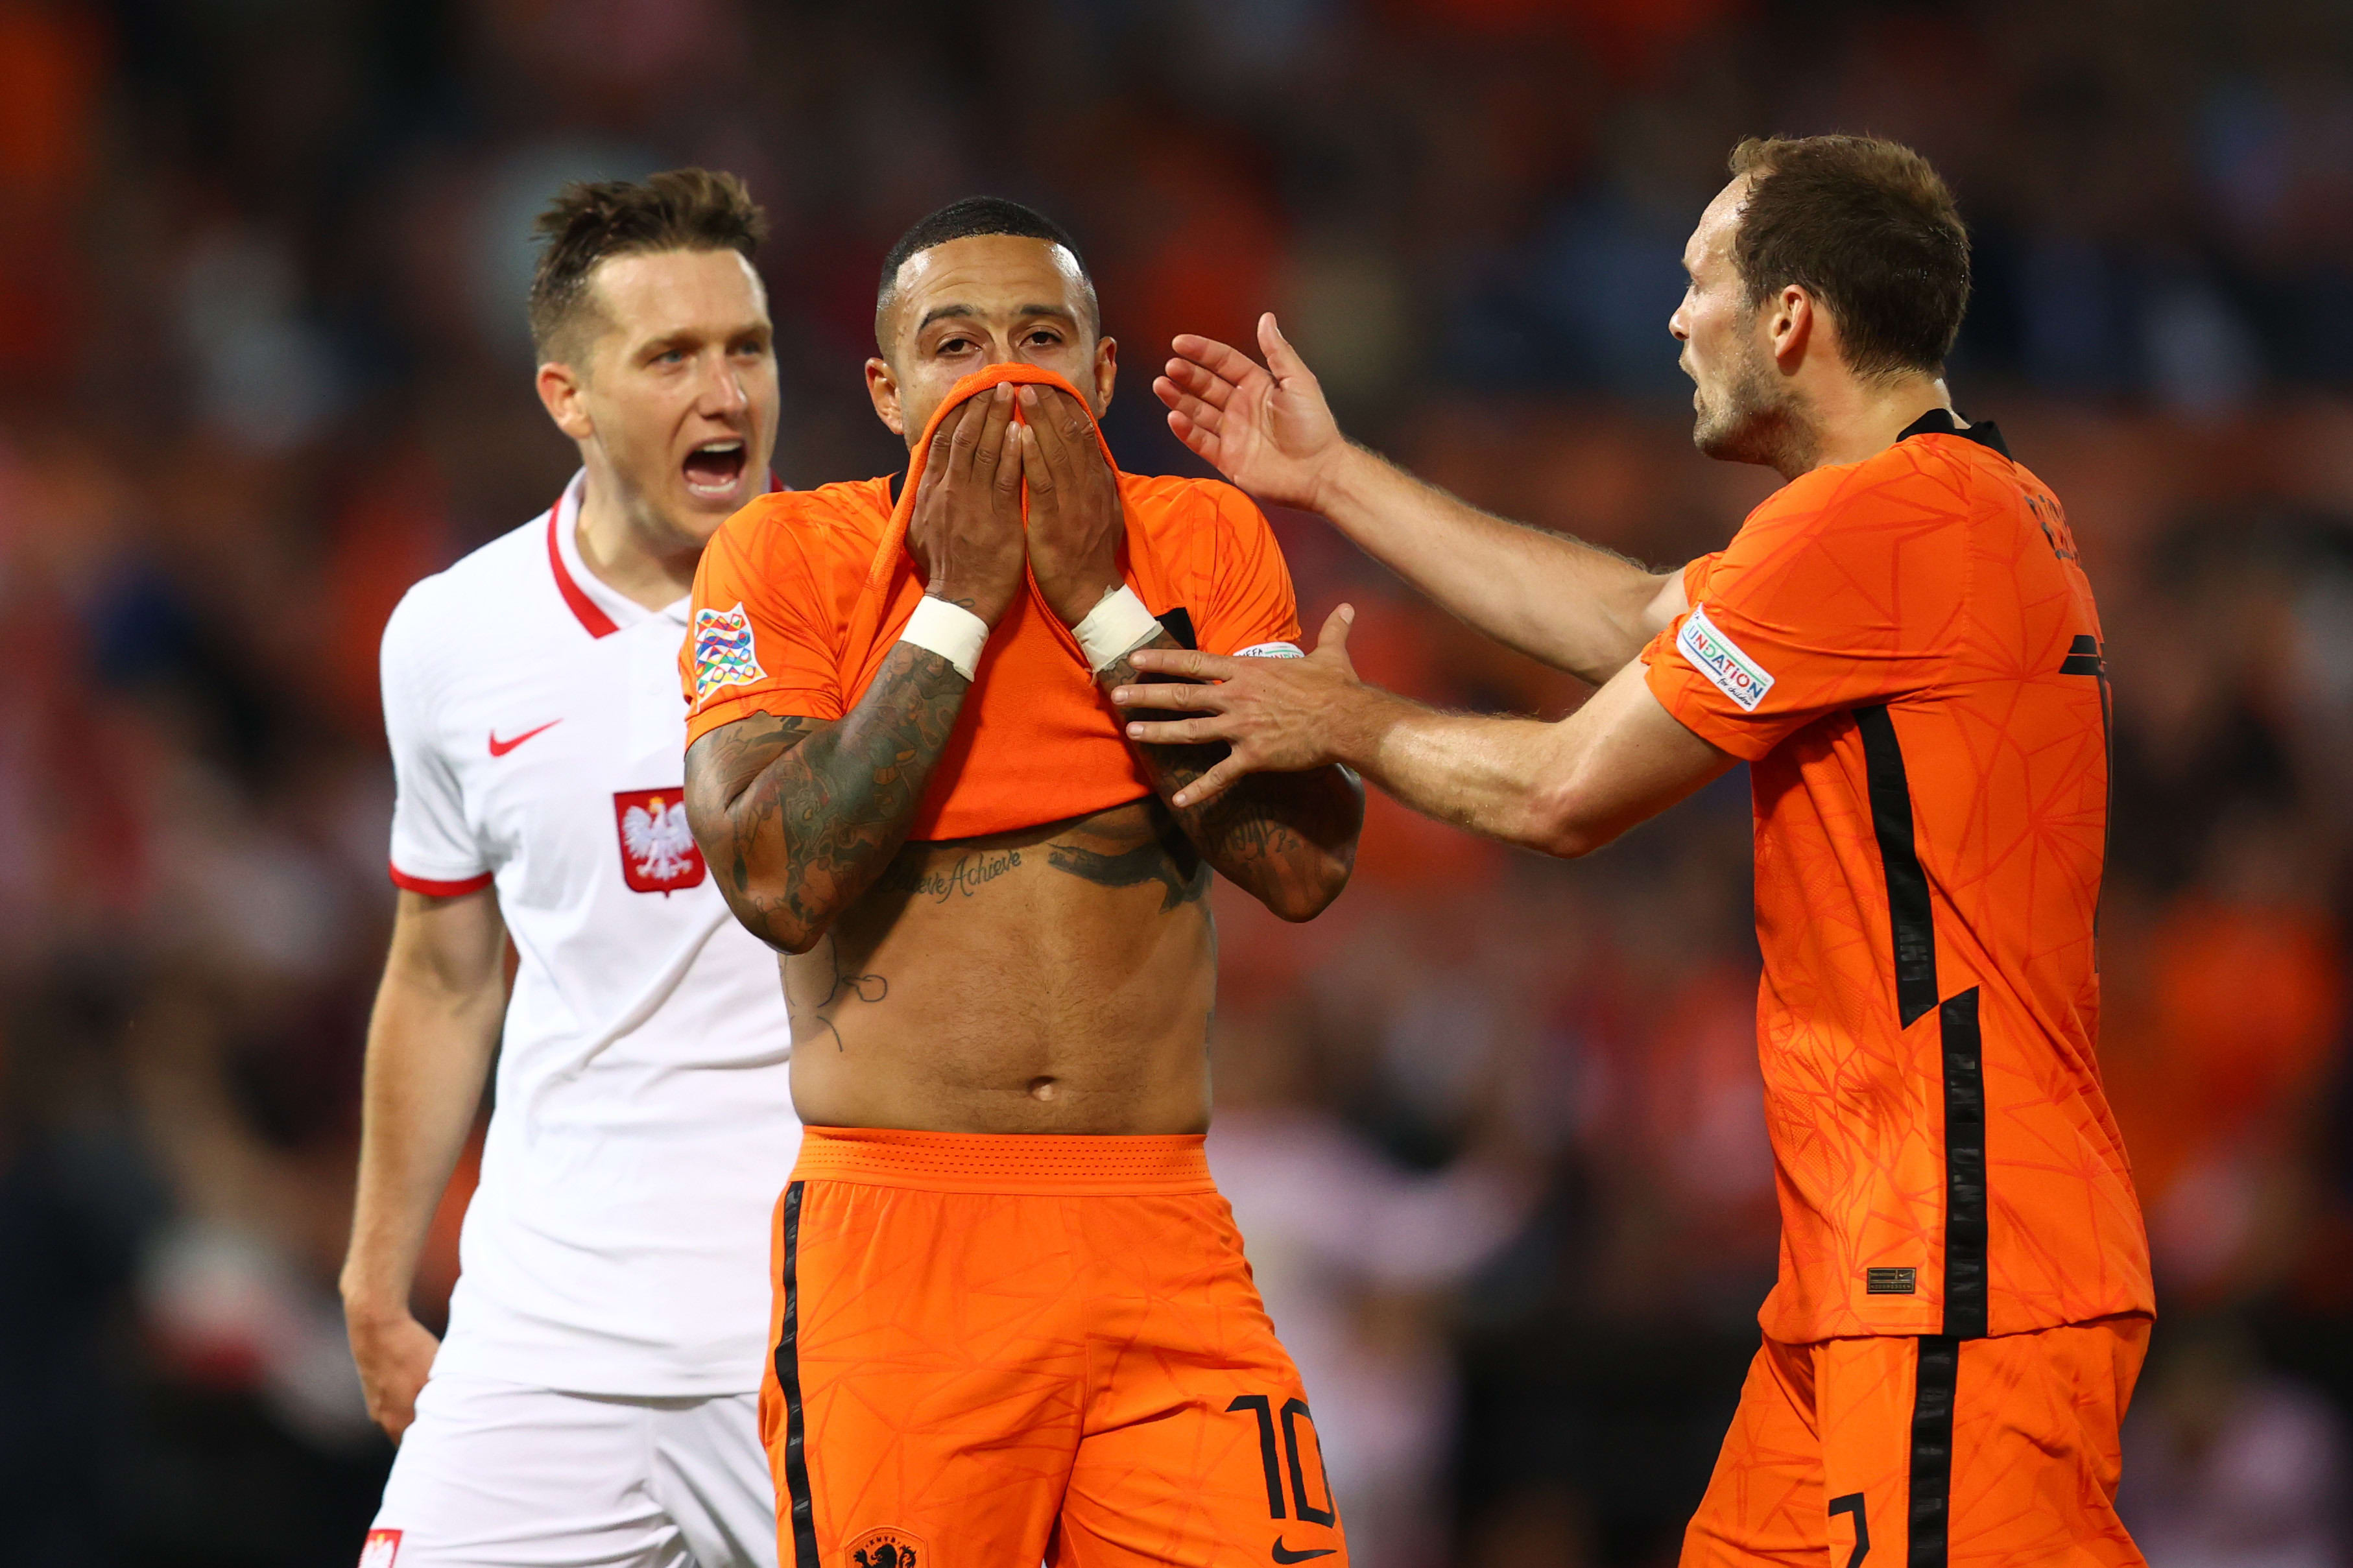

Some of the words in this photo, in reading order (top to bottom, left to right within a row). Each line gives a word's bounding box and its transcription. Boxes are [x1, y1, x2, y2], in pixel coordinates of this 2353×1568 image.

[1729, 687, 1752, 707] children
[937, 850, 1021, 904] Achieve
[1224, 1394, 1336, 1529] 10
